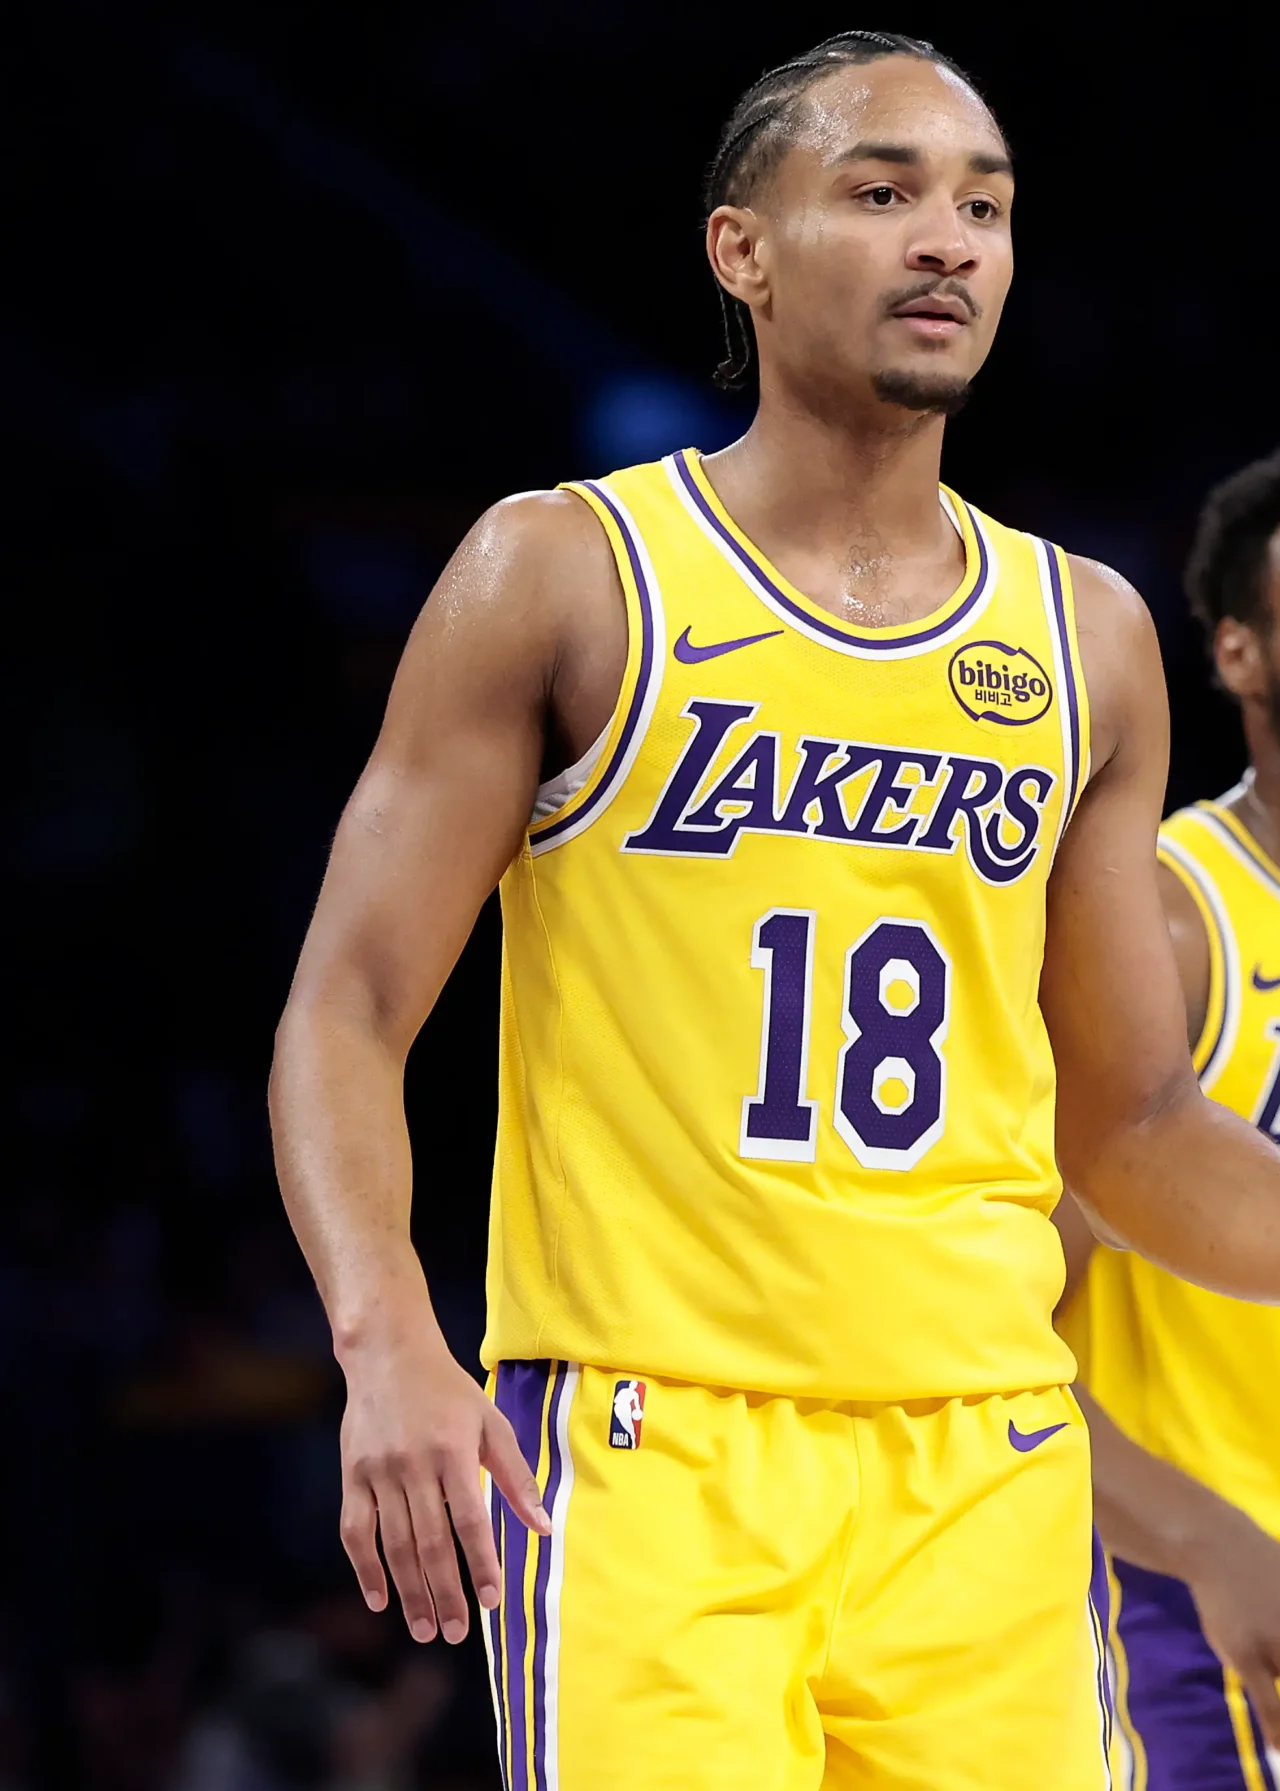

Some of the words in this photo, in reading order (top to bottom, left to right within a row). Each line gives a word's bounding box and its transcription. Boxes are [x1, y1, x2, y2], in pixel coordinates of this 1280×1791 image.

[958, 660, 1046, 703] bibigo
[975, 689, 1012, 706] 비비고
[621, 698, 1056, 887] LAKERS
[741, 907, 952, 1170] 18
[611, 1432, 629, 1447] NBA
